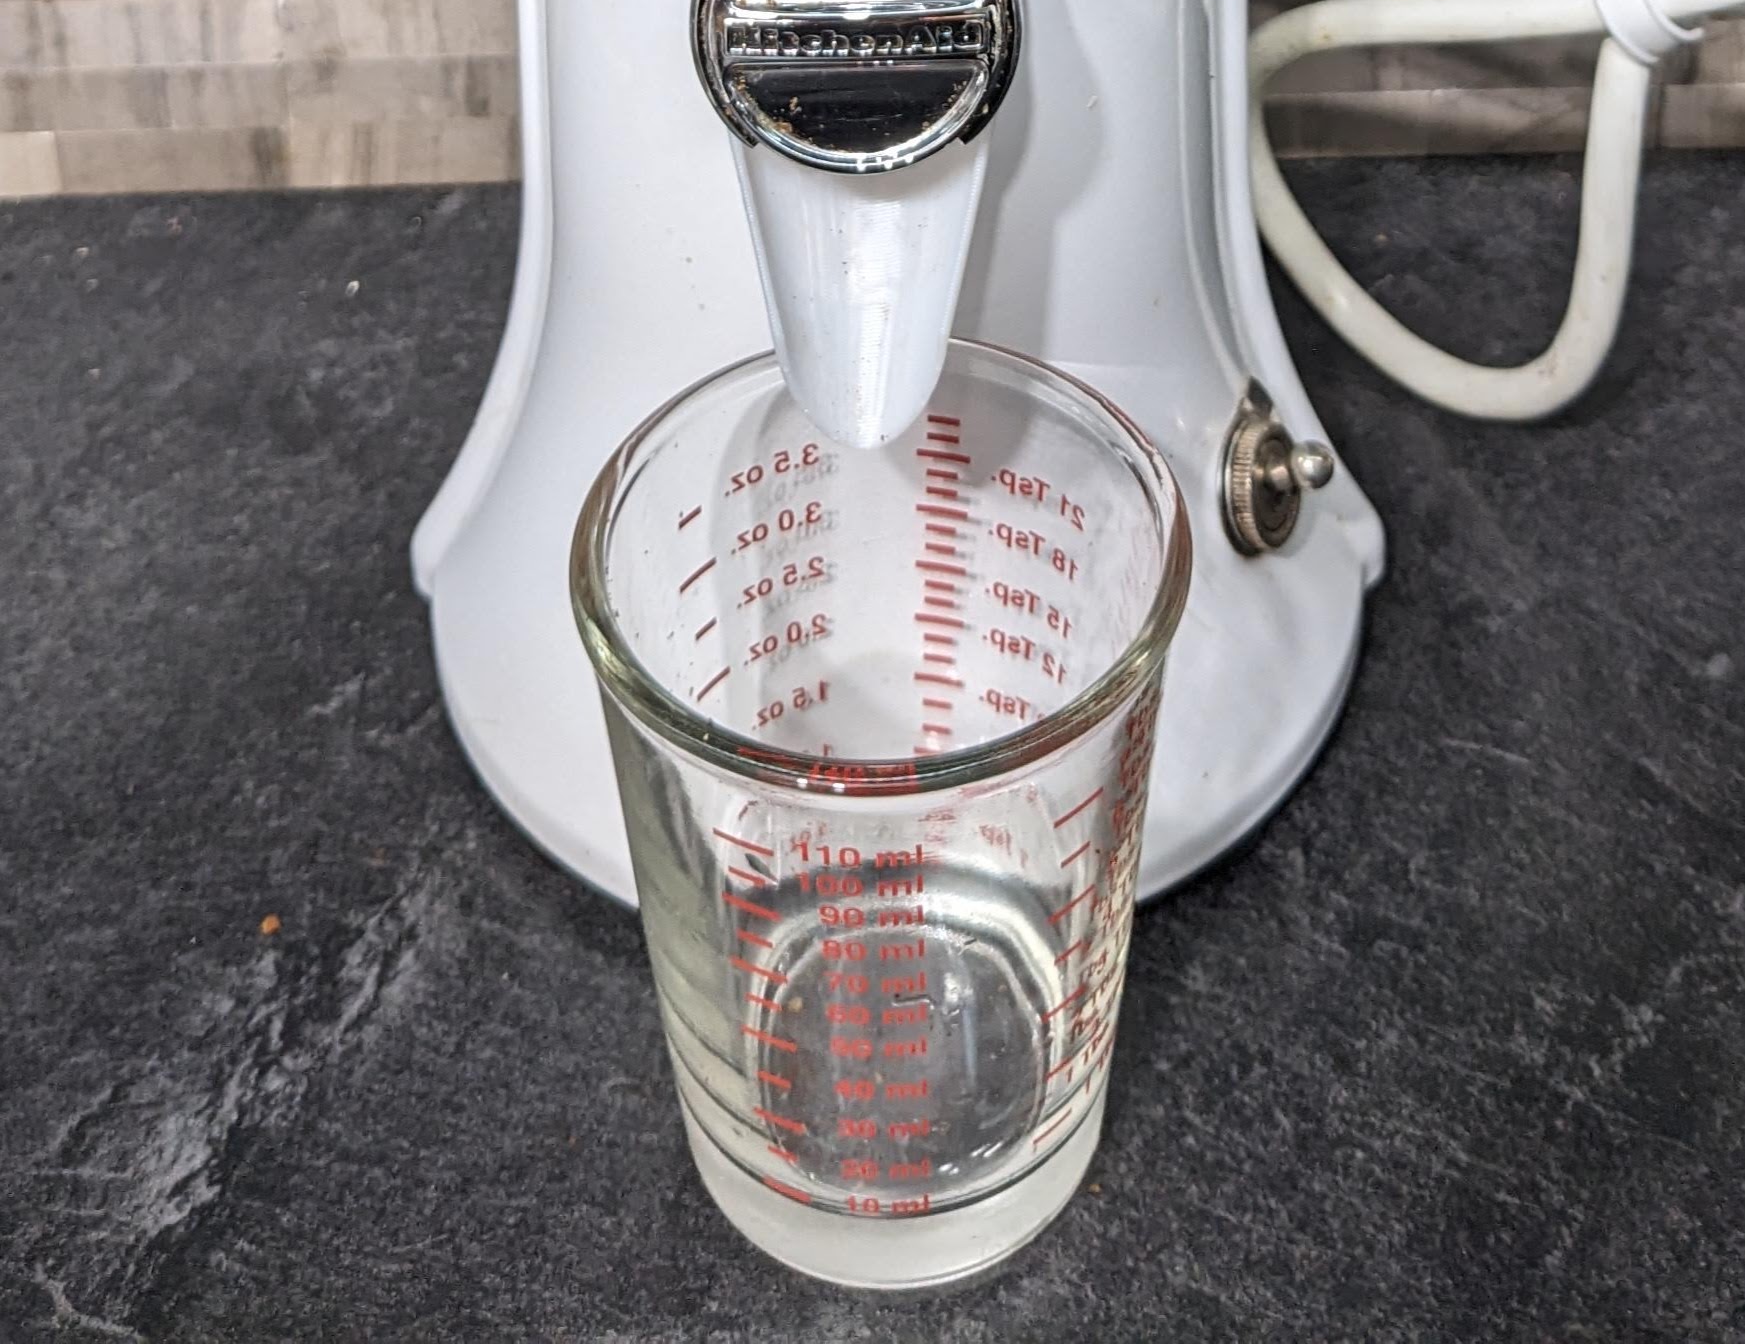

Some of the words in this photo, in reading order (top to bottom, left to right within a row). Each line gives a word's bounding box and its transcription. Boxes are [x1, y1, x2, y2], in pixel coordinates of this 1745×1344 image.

[796, 841, 862, 869] 110
[874, 844, 923, 868] ml
[797, 872, 865, 897] 100
[877, 875, 924, 897] ml
[818, 904, 866, 928] 90
[878, 905, 925, 927] ml
[821, 939, 867, 960] 80
[879, 938, 925, 960] ml
[823, 970, 869, 994] 70
[881, 970, 926, 993] ml
[826, 1002, 871, 1025] 60
[882, 1002, 927, 1024] ml
[847, 1195, 880, 1214] 10
[892, 1194, 929, 1214] ml
